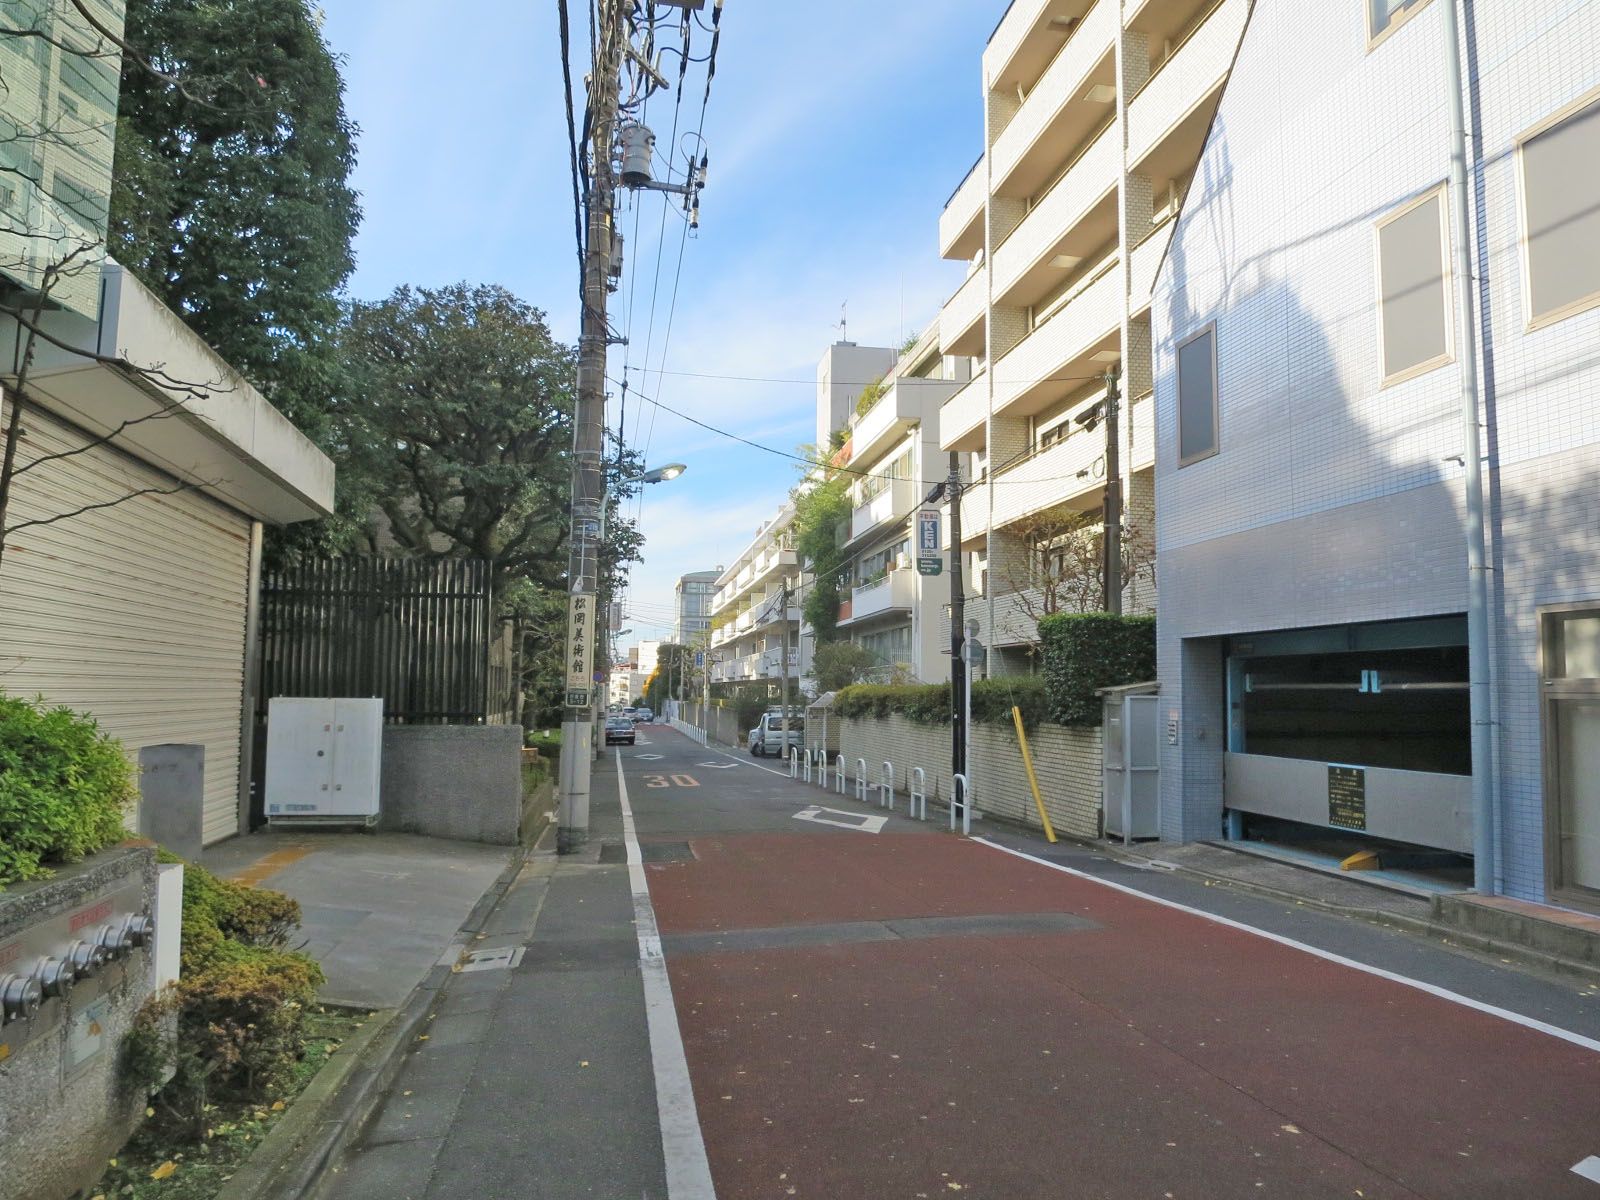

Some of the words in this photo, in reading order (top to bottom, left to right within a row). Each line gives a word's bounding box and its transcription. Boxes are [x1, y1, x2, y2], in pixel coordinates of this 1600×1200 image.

[924, 521, 935, 549] KEN
[572, 597, 586, 673] 松岡美術館
[643, 774, 701, 788] 30
